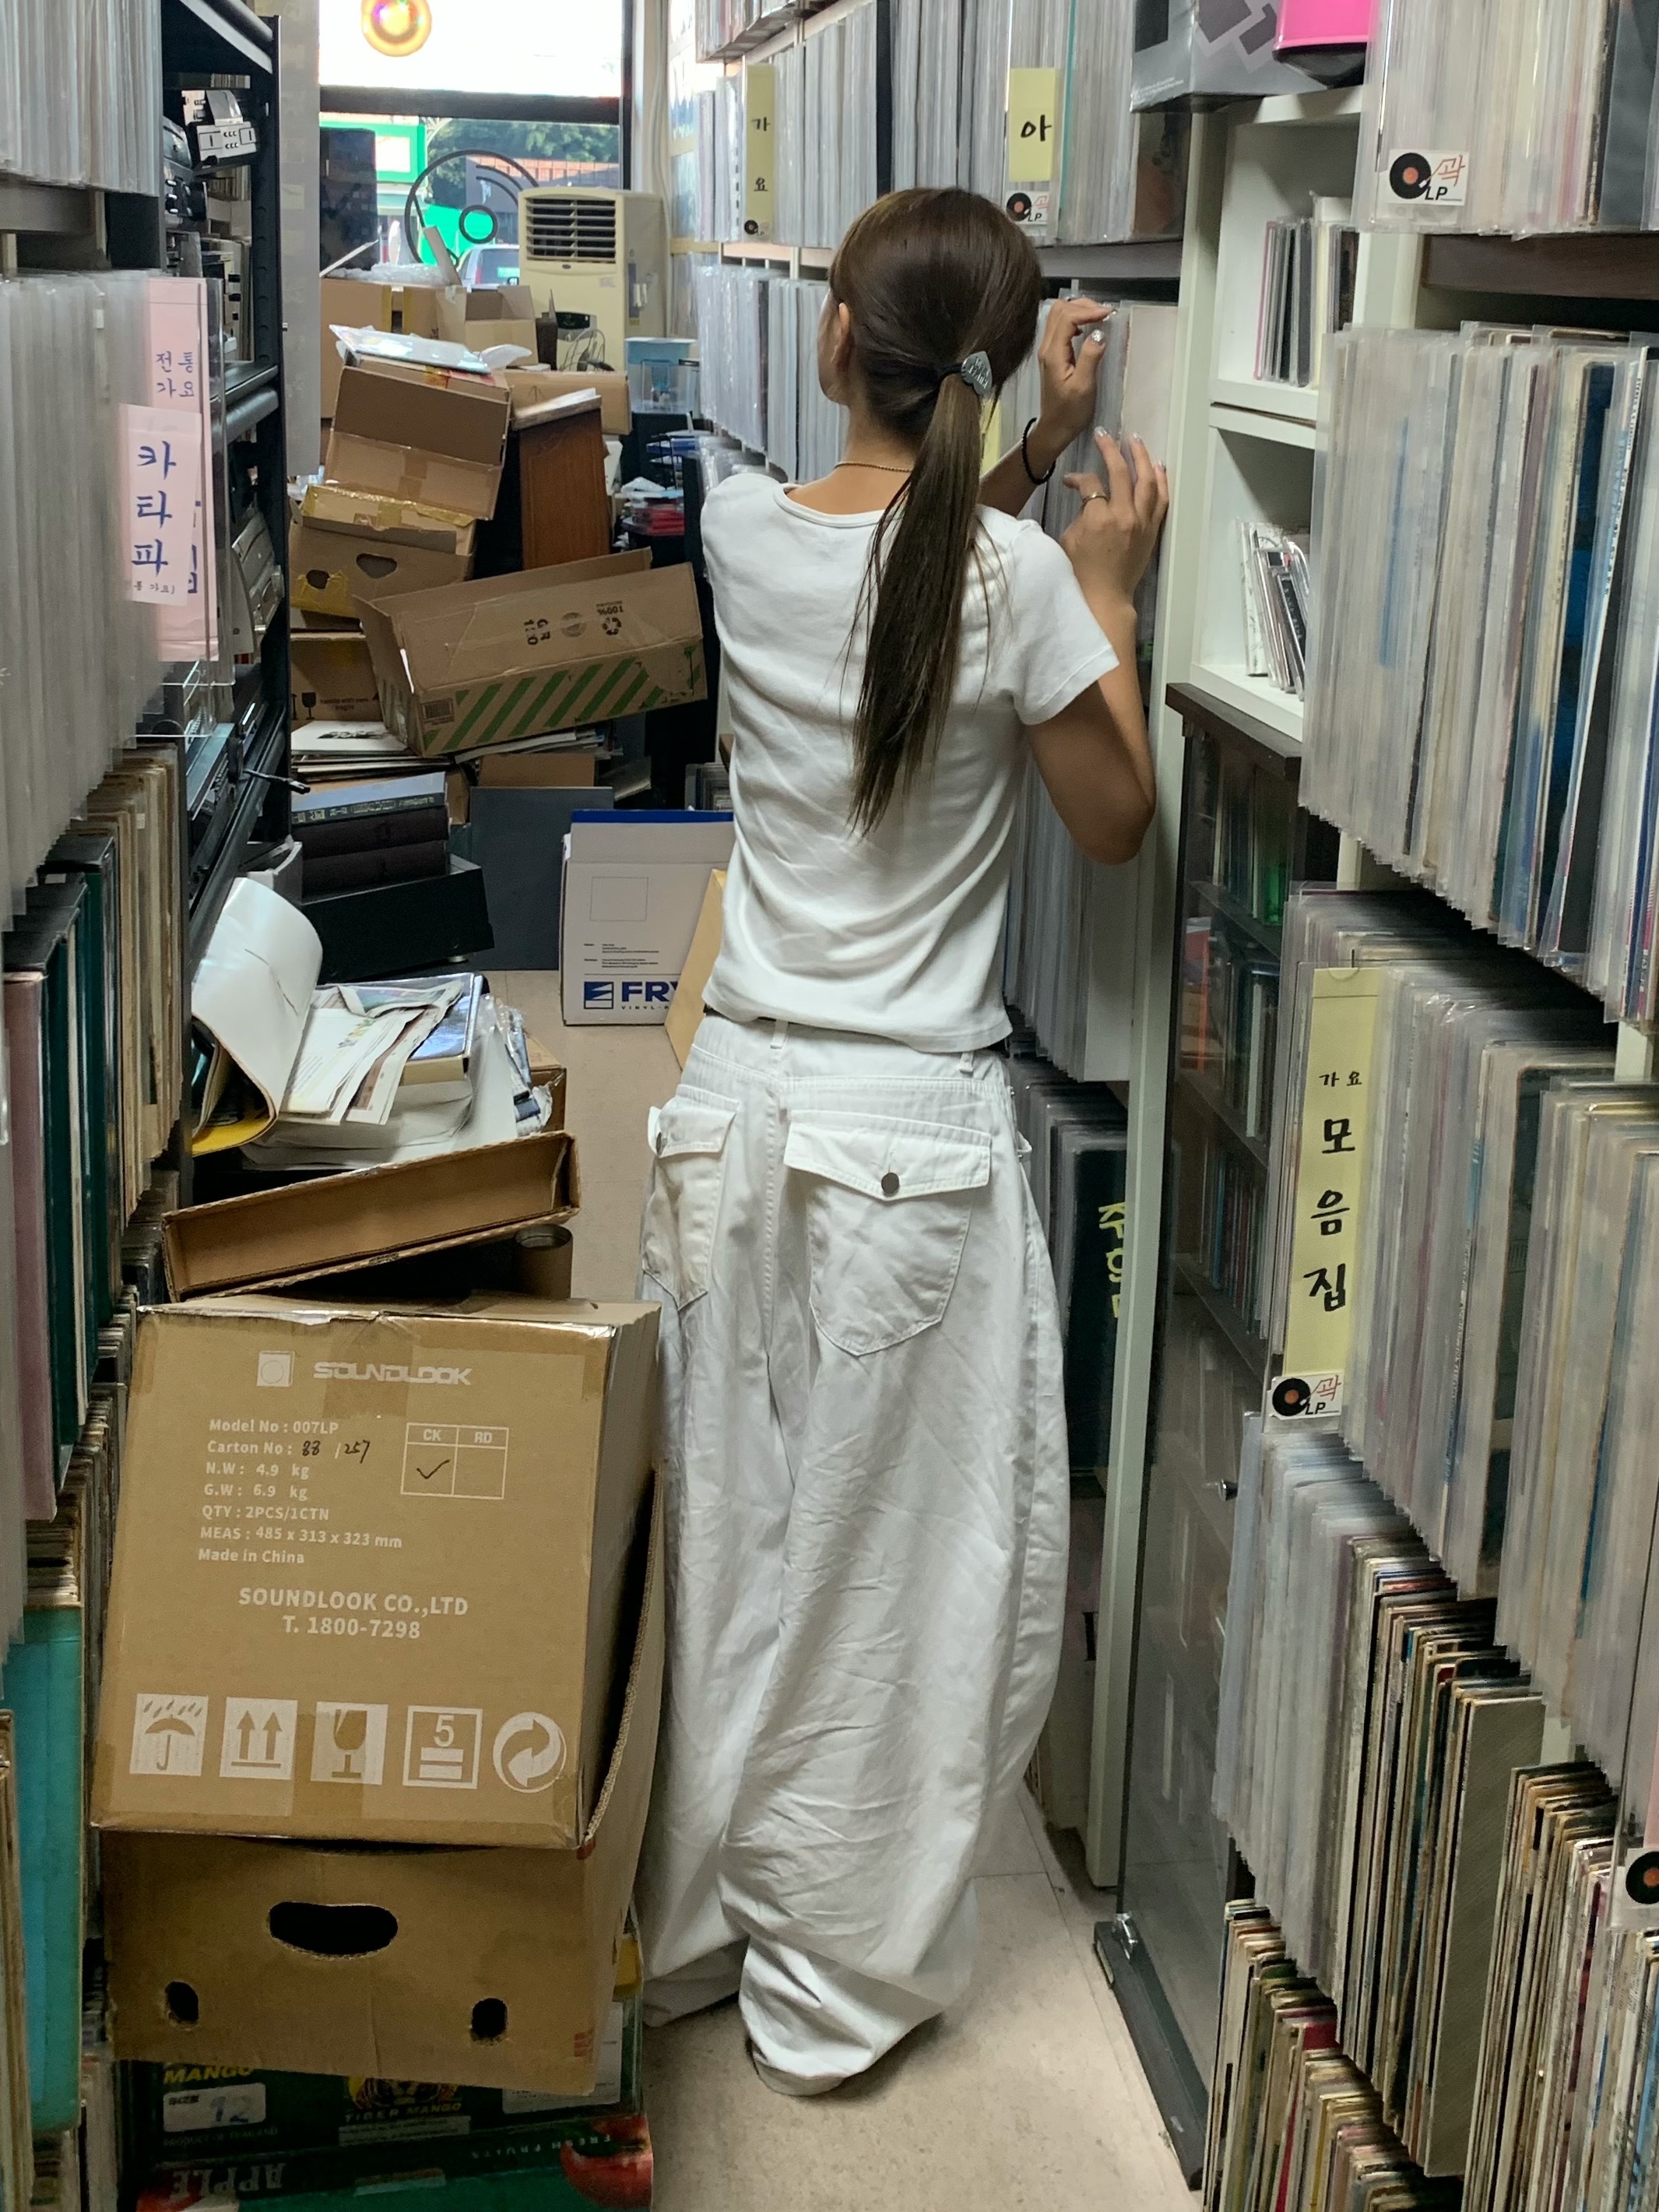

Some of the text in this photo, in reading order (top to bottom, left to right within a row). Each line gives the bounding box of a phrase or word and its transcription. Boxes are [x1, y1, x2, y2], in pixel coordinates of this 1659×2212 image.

[1021, 114, 1052, 142] 아
[1425, 186, 1448, 200] LP
[1028, 213, 1042, 222] LP
[155, 351, 193, 373] 전통
[156, 378, 195, 398] 가요
[132, 441, 177, 576] 카 타 파
[1319, 1071, 1362, 1087] 가요
[313, 1362, 473, 1386] SOUNDLOOK
[1306, 1402, 1327, 1415] LP
[209, 1419, 255, 1432] Model
[293, 1421, 339, 1434] 007LP
[424, 1429, 442, 1441] CK
[207, 1440, 258, 1454] Carton
[256, 1464, 279, 1476] 4.9
[292, 1464, 310, 1479] kg
[253, 1484, 276, 1497] 6.9
[290, 1486, 308, 1501] kg
[245, 1507, 329, 1521] 2PCS/1CTN
[256, 1527, 282, 1540] 485
[299, 1529, 326, 1543] 313
[343, 1532, 370, 1546] 323
[374, 1535, 402, 1549] mm
[199, 1547, 304, 1563] Made in China
[238, 1588, 469, 1618] SOUNDLOOK CO.,LTD
[282, 1615, 420, 1639] T. 1800-7298
[433, 1714, 455, 1747] 5
[168, 2162, 286, 2199] APPLE
